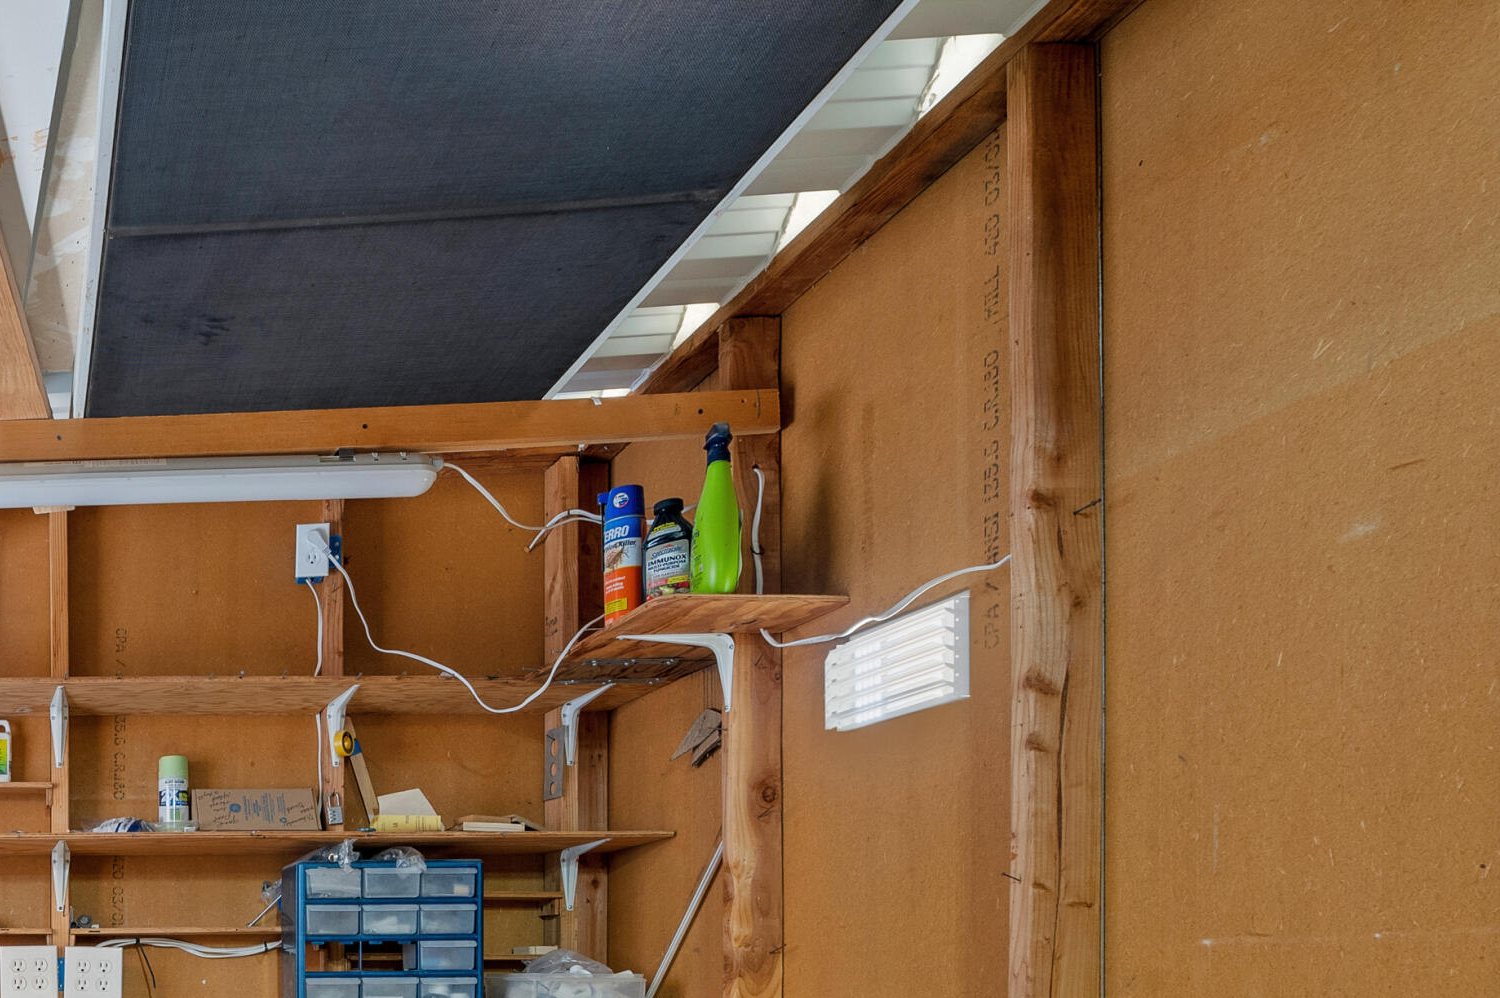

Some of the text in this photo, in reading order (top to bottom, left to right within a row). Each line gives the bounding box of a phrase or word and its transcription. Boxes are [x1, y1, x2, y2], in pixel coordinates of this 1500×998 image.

[115, 627, 127, 653] CPA
[984, 603, 1000, 649] CPA
[113, 713, 126, 746] 35.6
